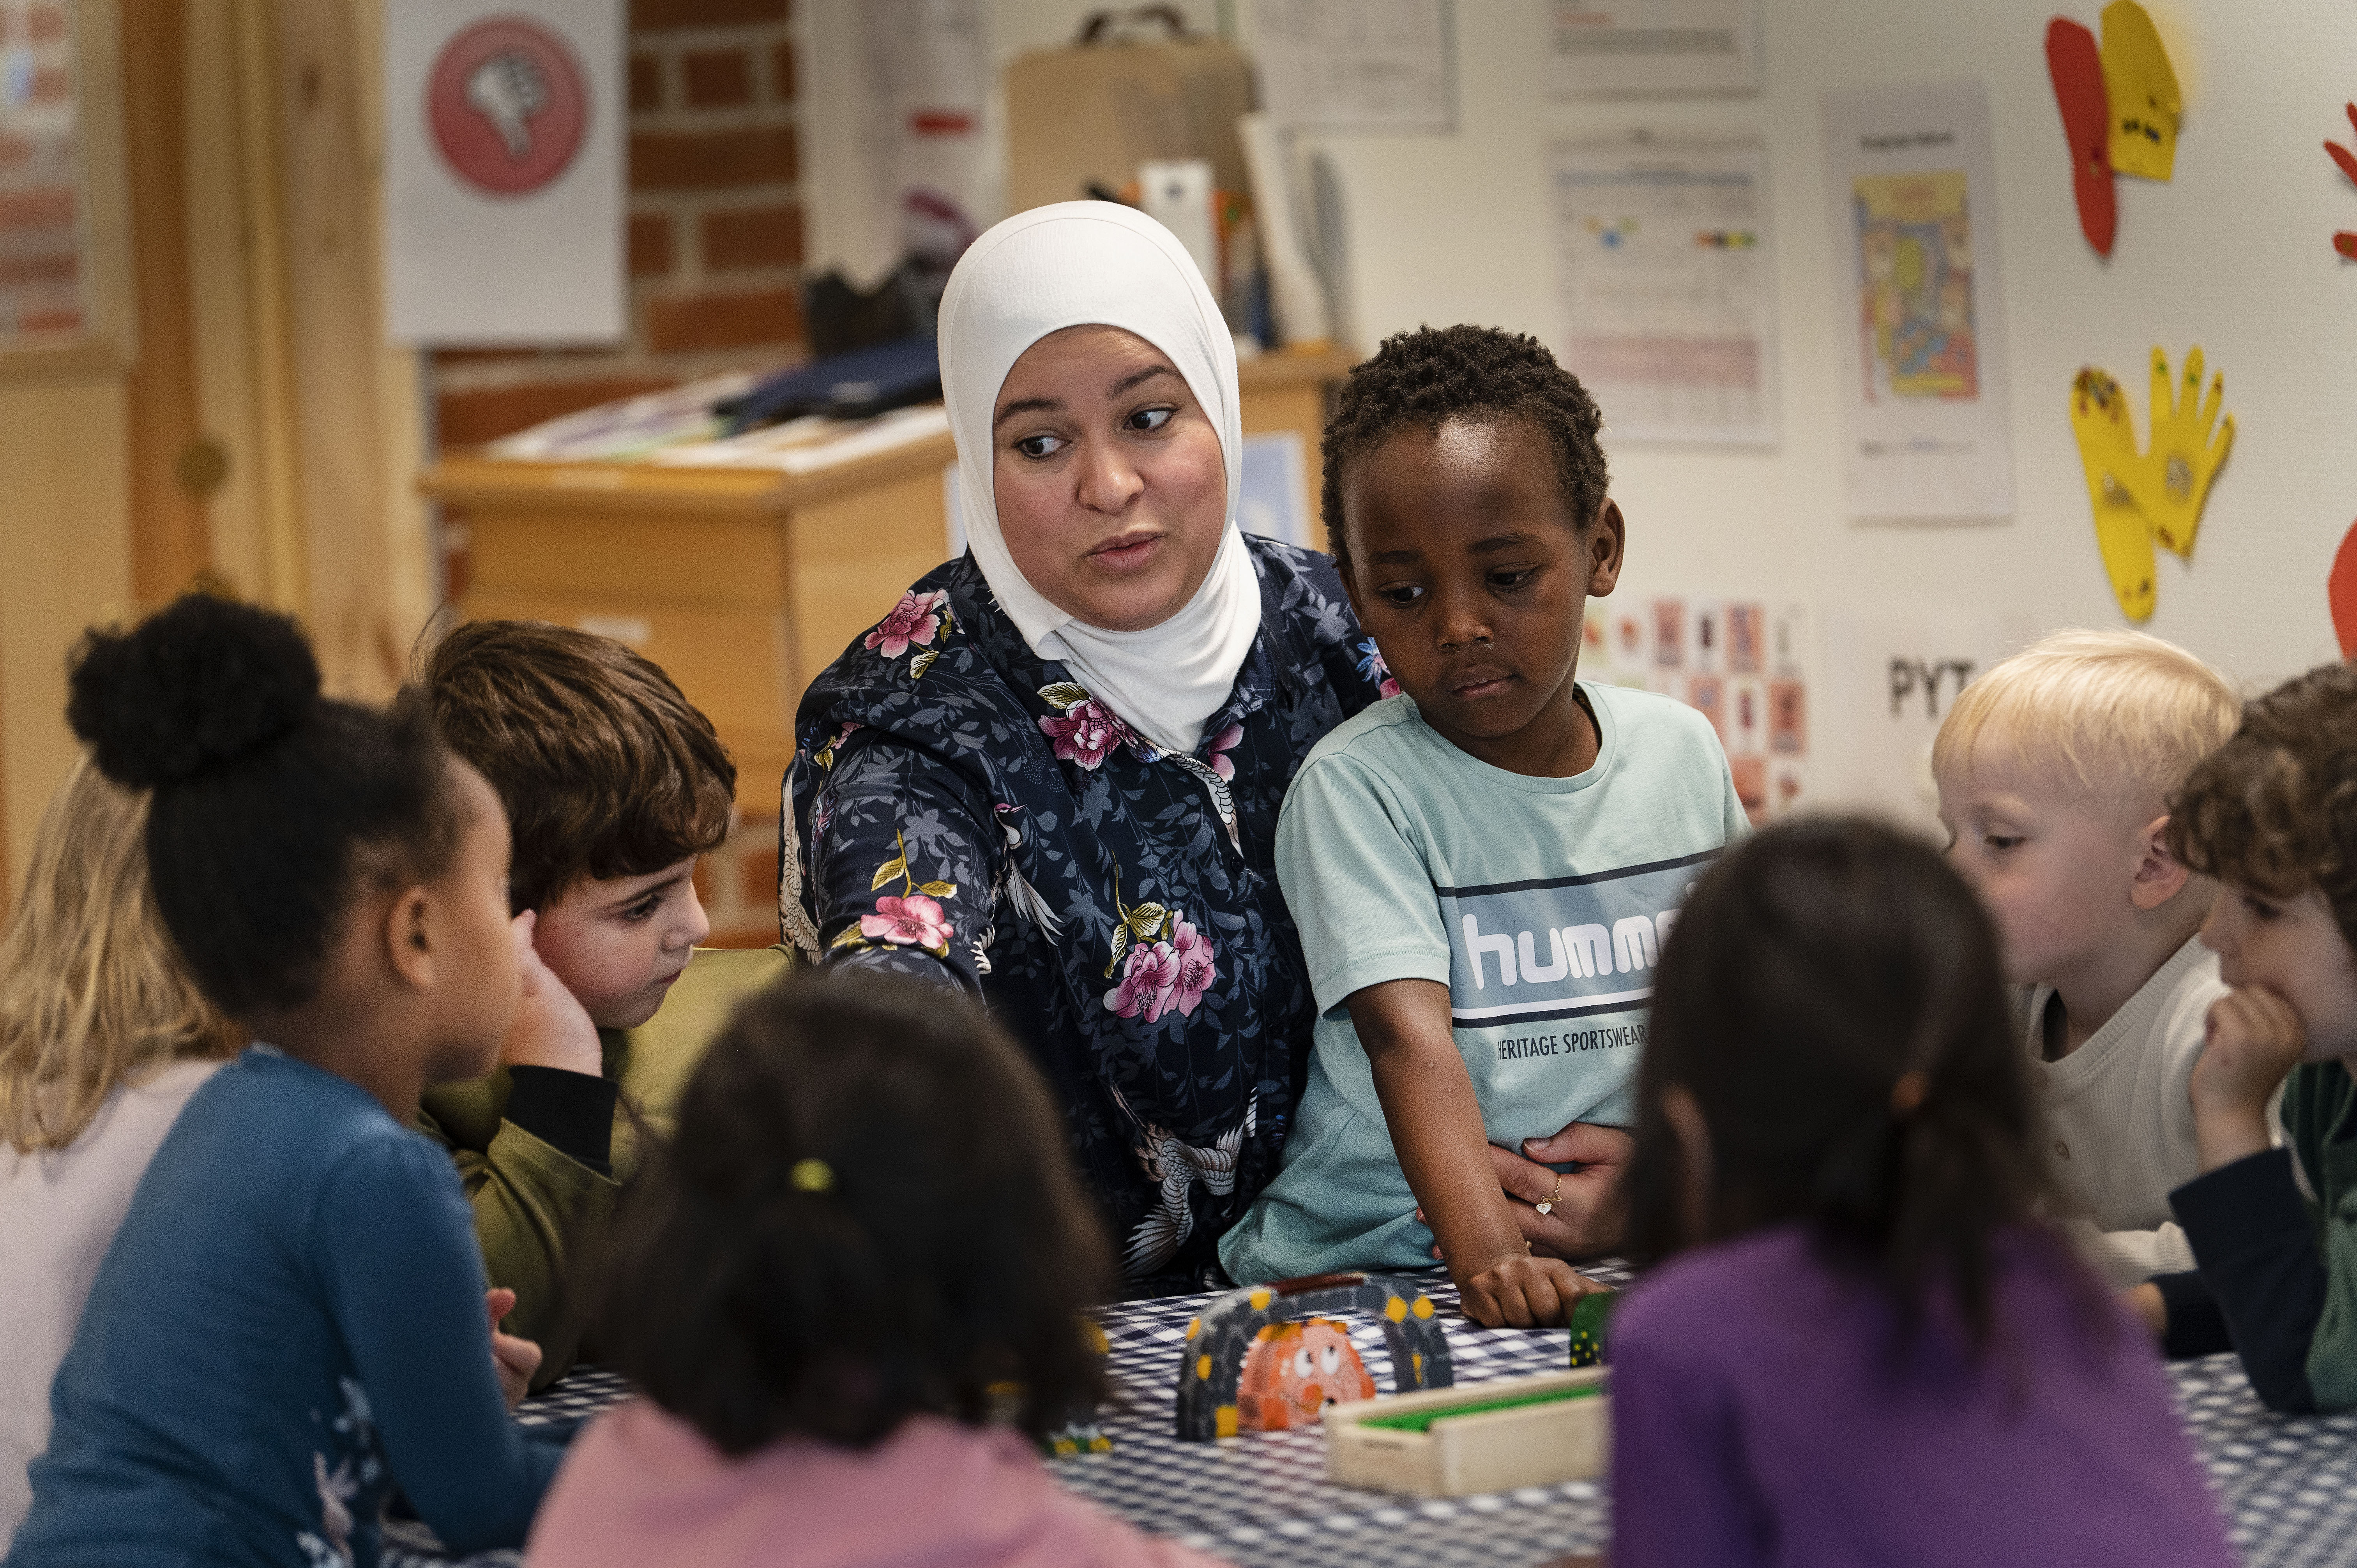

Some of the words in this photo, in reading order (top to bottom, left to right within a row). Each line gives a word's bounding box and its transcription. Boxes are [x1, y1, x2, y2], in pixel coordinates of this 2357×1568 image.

[1462, 882, 1700, 990] humm
[1498, 1035, 1558, 1060] HERITAGE
[1563, 1024, 1648, 1053] SPORTSWEAR
